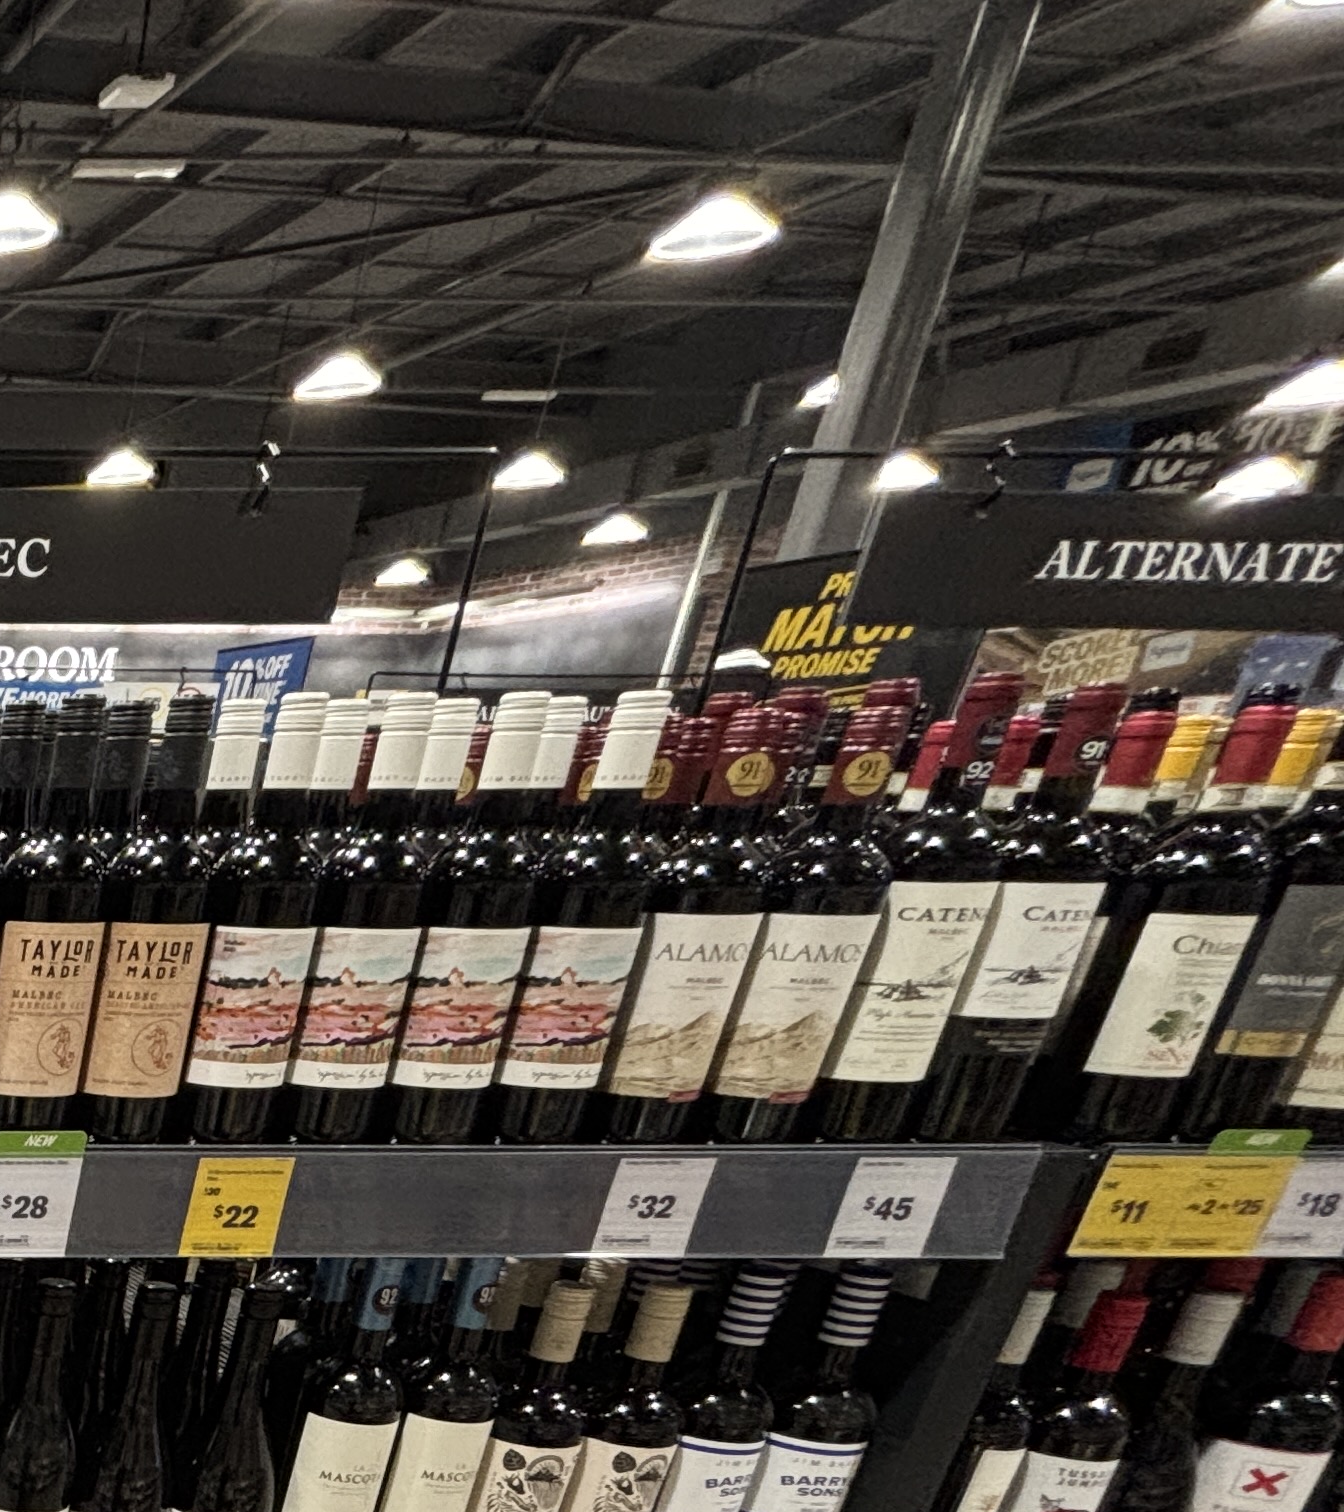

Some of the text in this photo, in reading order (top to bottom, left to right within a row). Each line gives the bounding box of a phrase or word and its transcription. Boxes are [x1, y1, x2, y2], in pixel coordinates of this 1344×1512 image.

[1033, 539, 1344, 584] ALTERNATE
[771, 647, 883, 679] PROMISE
[20, 937, 95, 963] TAYLOR
[115, 938, 194, 964] TAYLOR
[30, 964, 82, 979] MADE
[11, 990, 63, 1002] MALBEC
[23, 1134, 57, 1148] NEW
[1, 1193, 49, 1219] $28
[213, 1204, 258, 1229] $22
[627, 1193, 677, 1220] $32
[863, 1195, 915, 1222] $45
